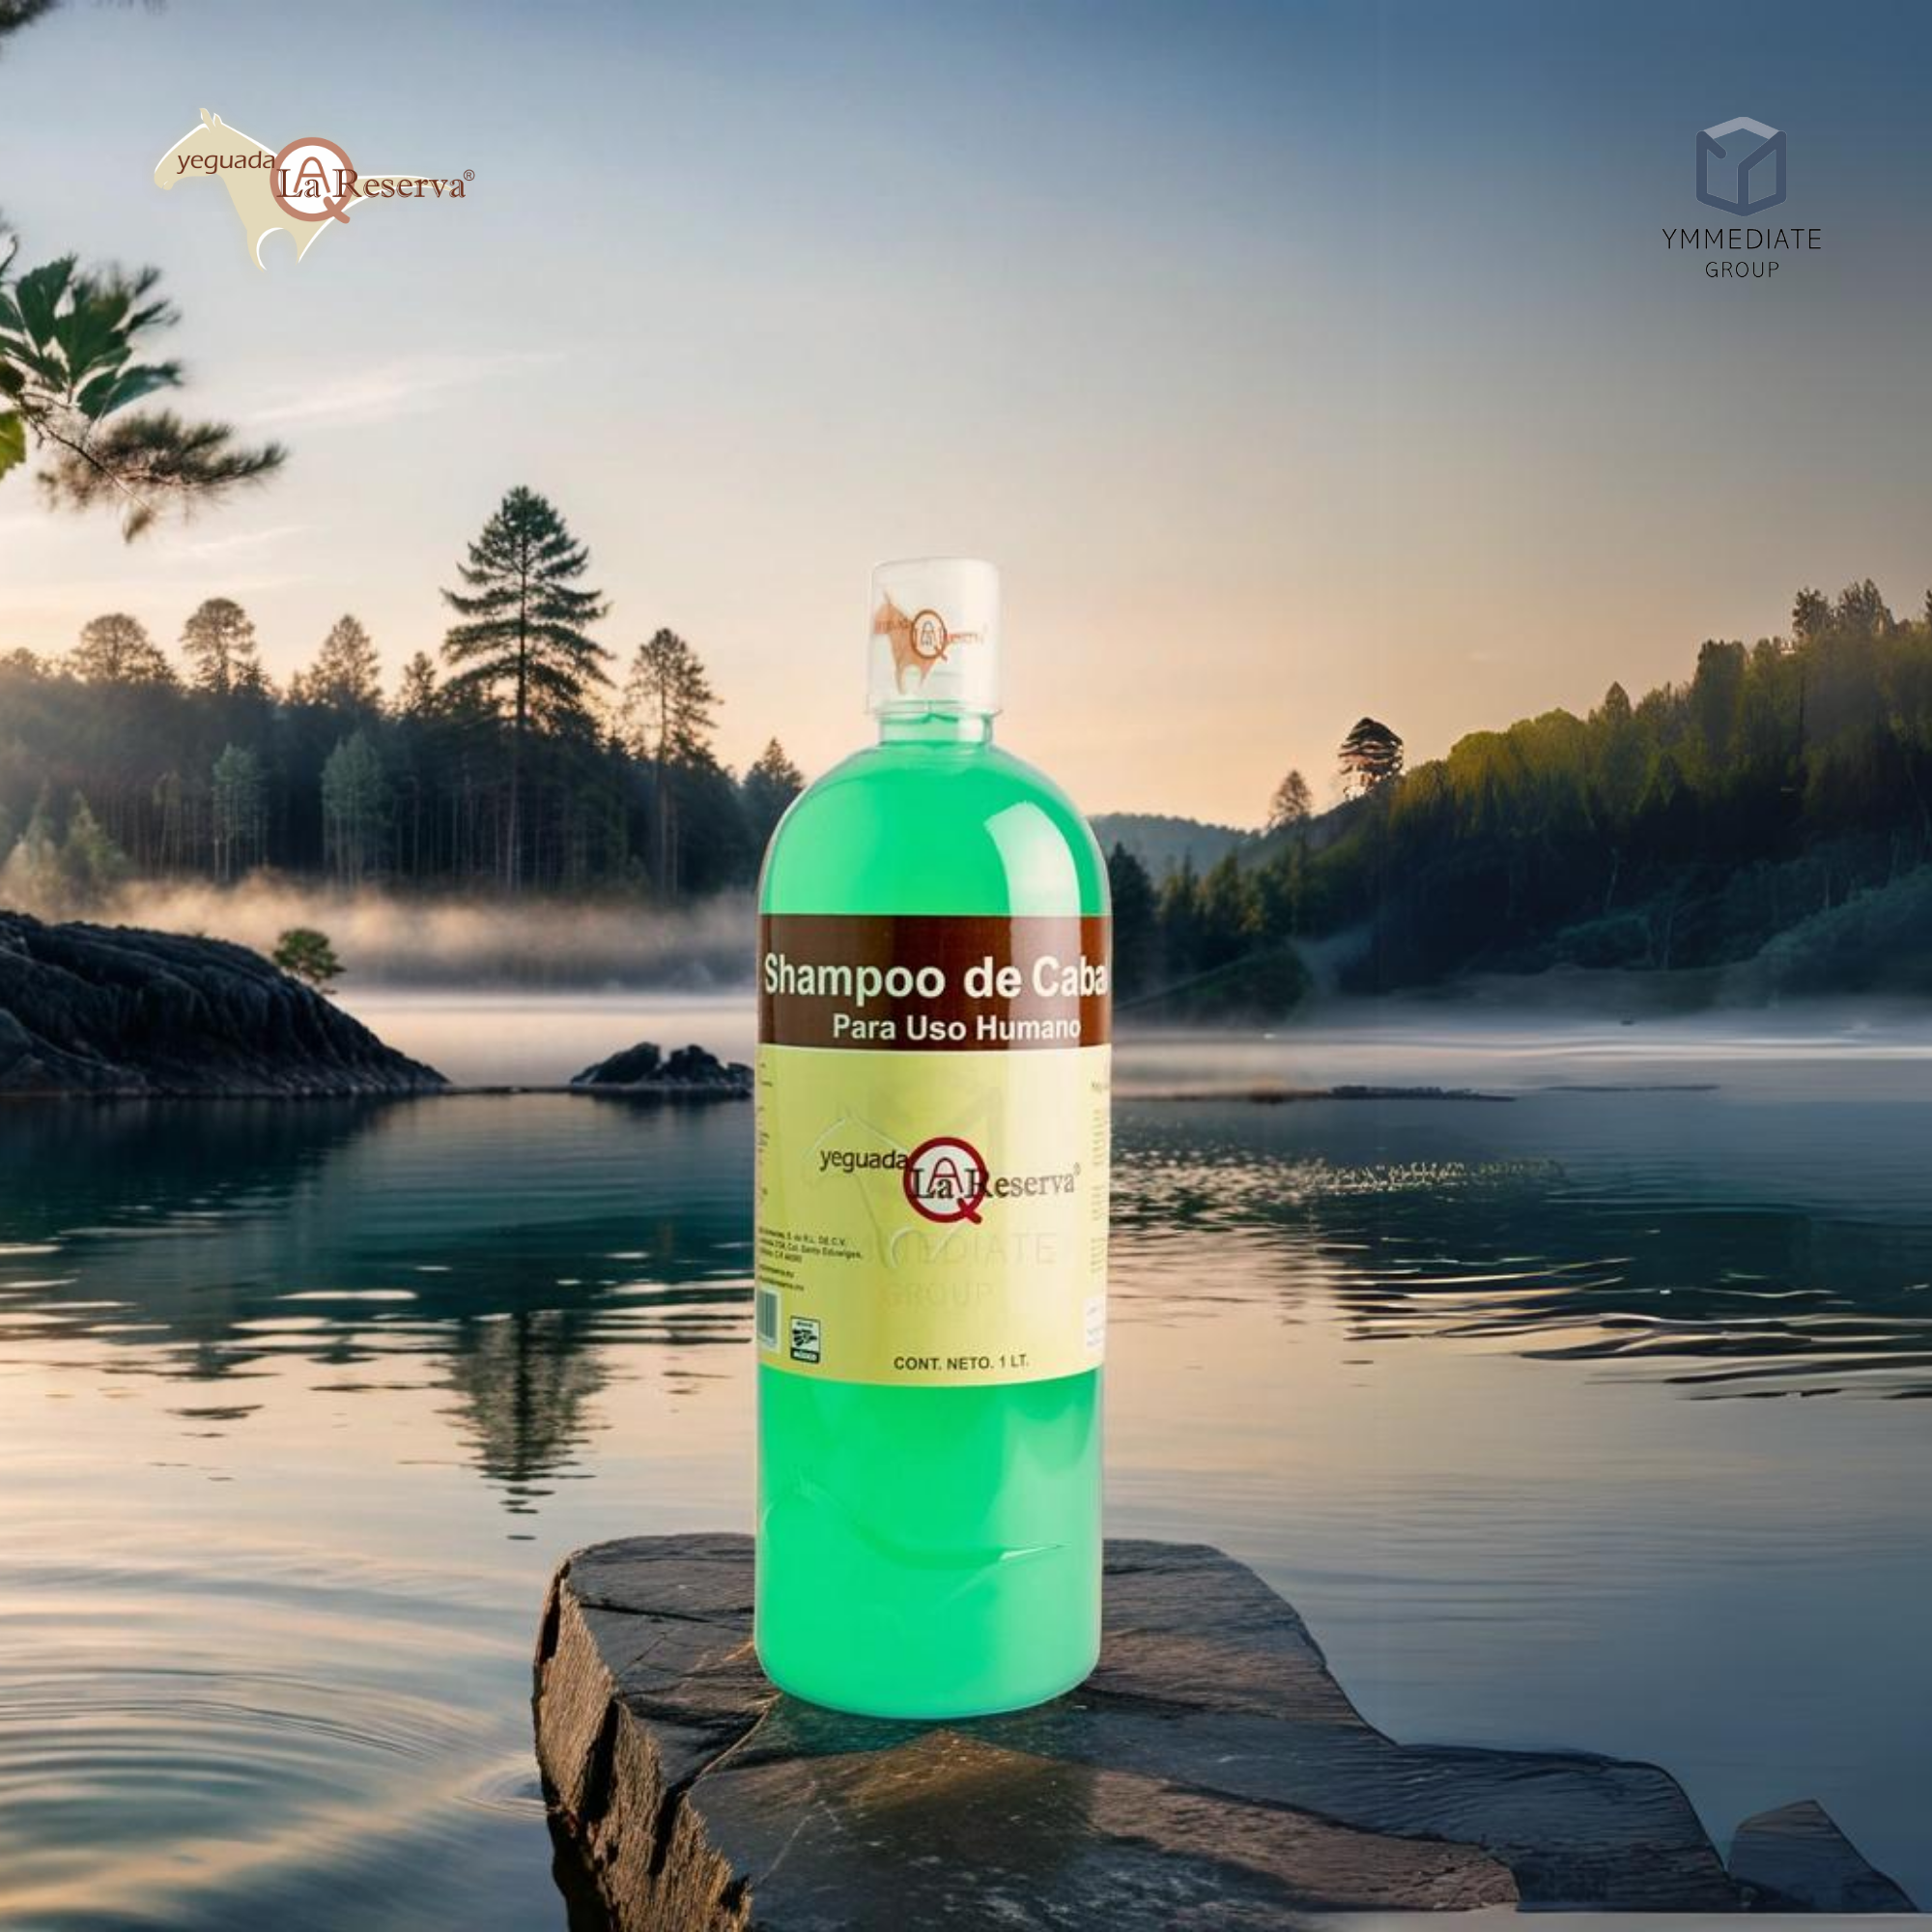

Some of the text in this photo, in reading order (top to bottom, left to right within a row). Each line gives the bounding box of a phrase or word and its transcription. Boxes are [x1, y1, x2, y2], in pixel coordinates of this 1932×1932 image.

[764, 952, 946, 1007] Shampoo
[963, 956, 1023, 998] de
[833, 1013, 1082, 1041] Para Uso Humano
[819, 1150, 908, 1173] yeguada
[894, 1356, 942, 1371] CONT.
[947, 1356, 994, 1370] NETO.
[1010, 1354, 1029, 1368] LT.
